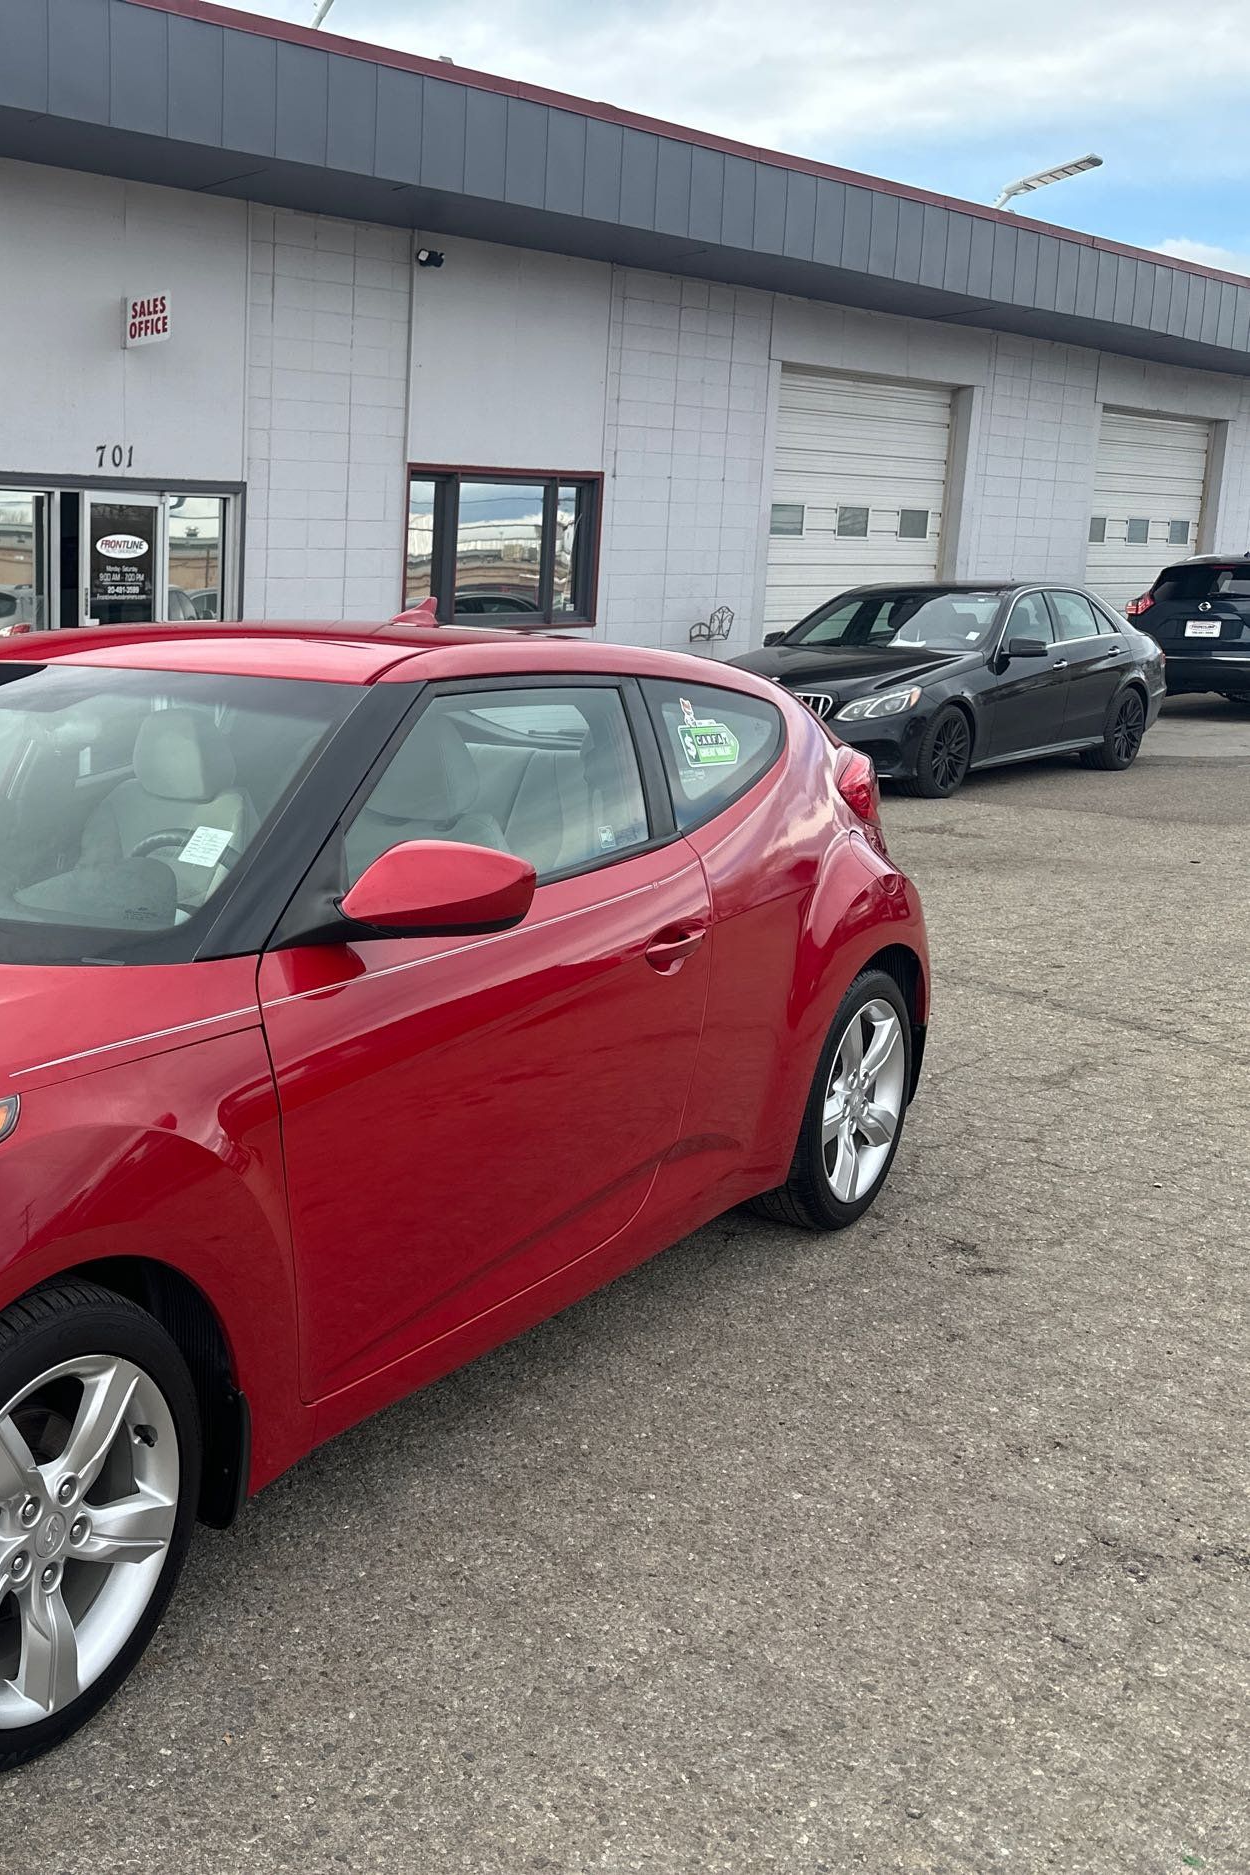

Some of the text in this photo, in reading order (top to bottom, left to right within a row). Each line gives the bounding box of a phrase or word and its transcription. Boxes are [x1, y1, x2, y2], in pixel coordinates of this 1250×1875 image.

[131, 295, 167, 320] SALES
[128, 315, 168, 340] OFFICE
[95, 444, 134, 468] 701
